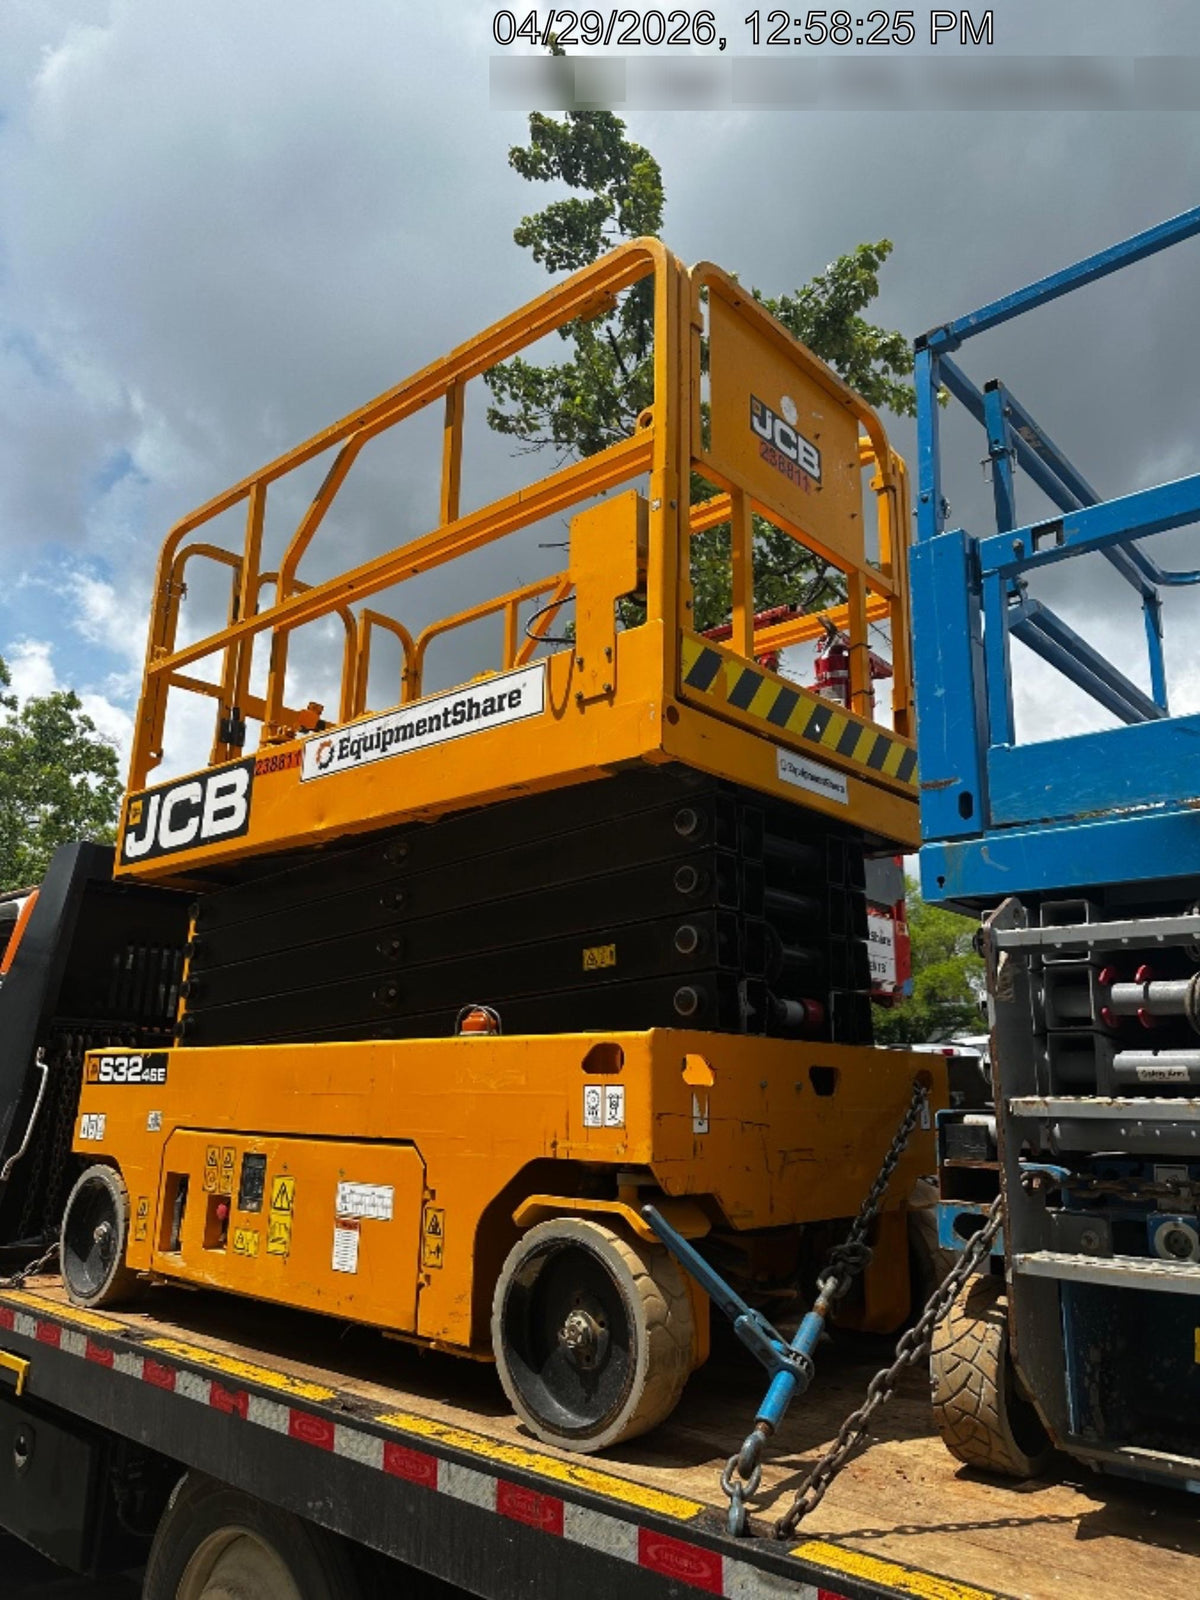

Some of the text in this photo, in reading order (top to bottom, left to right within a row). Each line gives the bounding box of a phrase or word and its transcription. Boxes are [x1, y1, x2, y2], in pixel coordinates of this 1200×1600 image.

[752, 408, 821, 480] JCB
[337, 687, 522, 761] EquipmentShare
[255, 749, 302, 776] 238811
[125, 768, 250, 857] JCB
